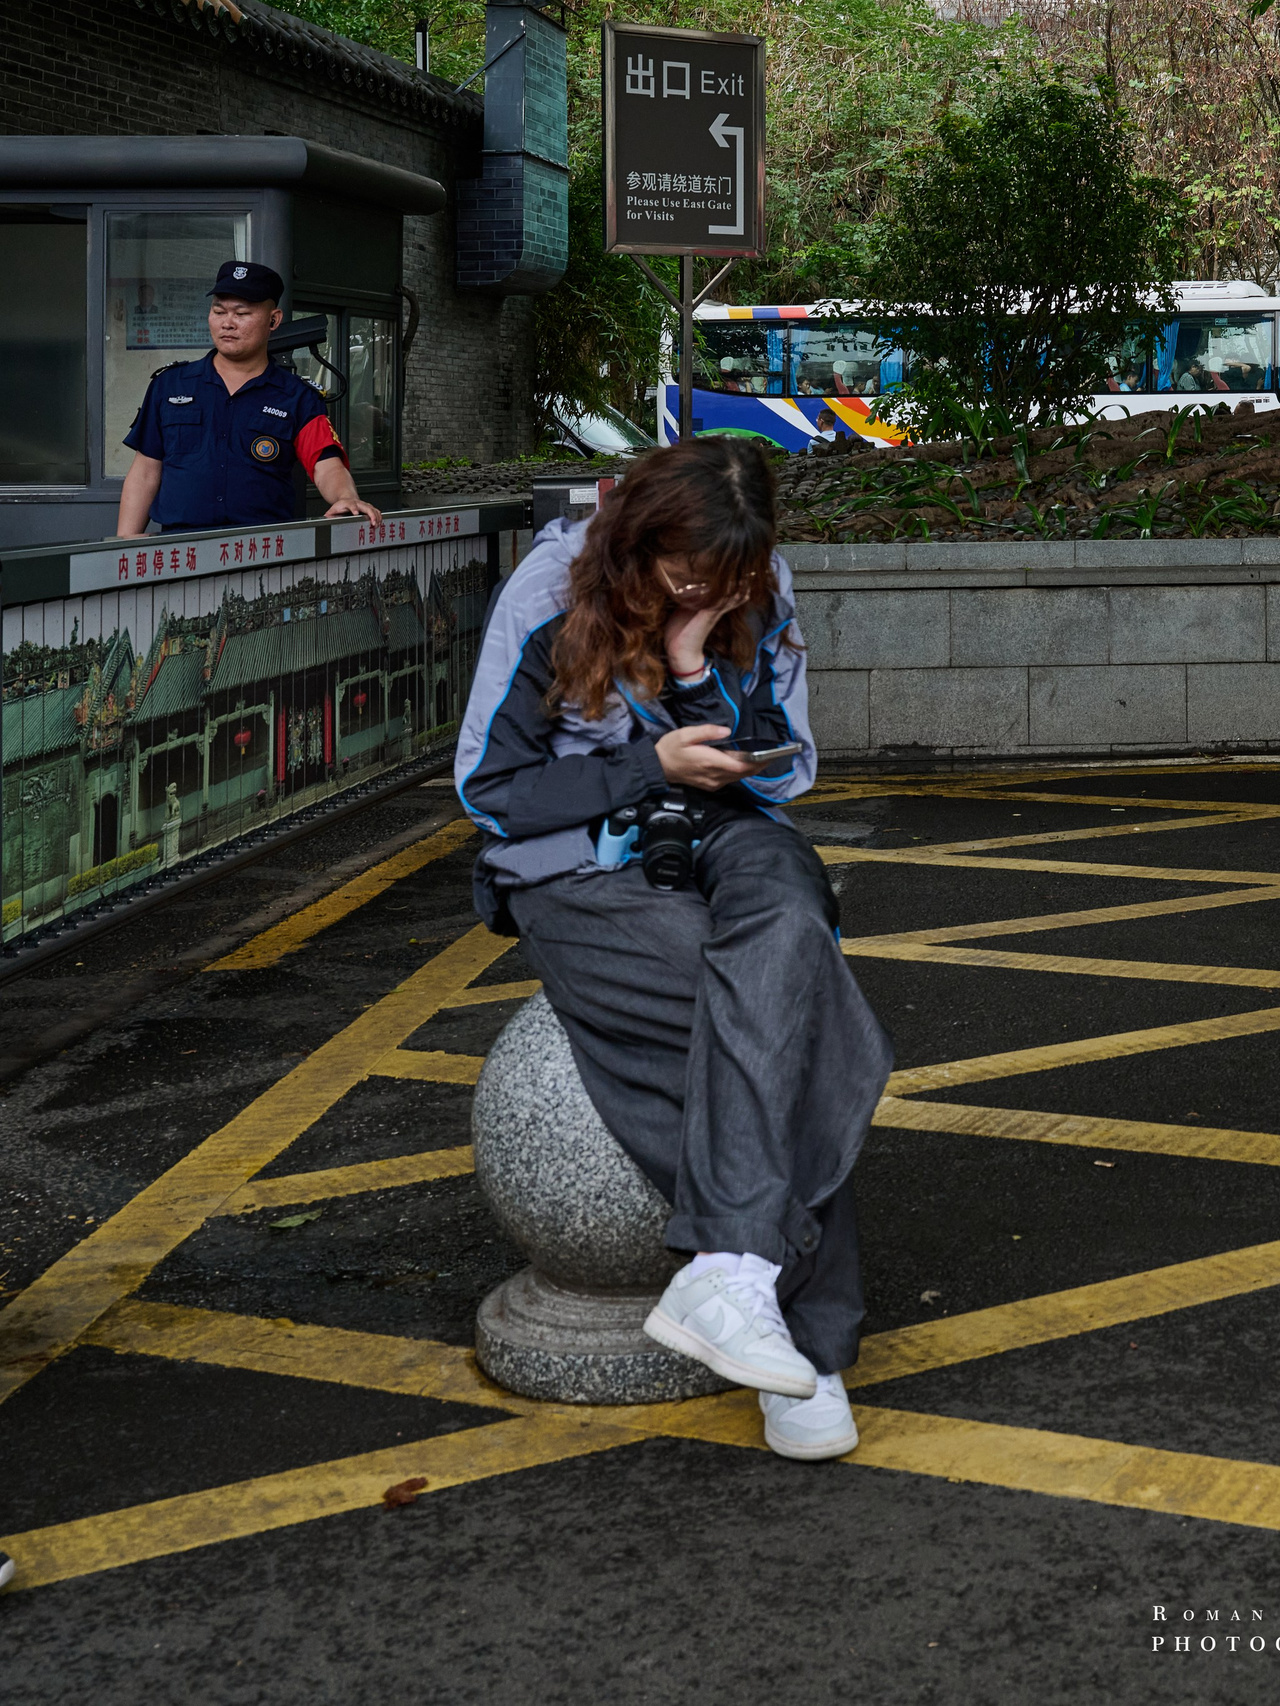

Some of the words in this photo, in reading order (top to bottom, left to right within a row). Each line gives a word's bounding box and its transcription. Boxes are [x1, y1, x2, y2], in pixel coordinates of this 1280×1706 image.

[625, 53, 691, 99] 出口
[701, 70, 745, 97] Exit
[626, 171, 732, 196] 参观请绕道东门
[626, 196, 660, 208] Please
[662, 198, 681, 208] Use
[683, 199, 706, 210] East
[707, 200, 732, 210] Gate
[626, 211, 643, 220] for
[645, 211, 675, 222] Visits
[358, 521, 406, 546] 内部停车场
[419, 515, 460, 539] 不对外开放
[118, 546, 197, 581] 内部停车场
[219, 534, 284, 566] 不对外开放
